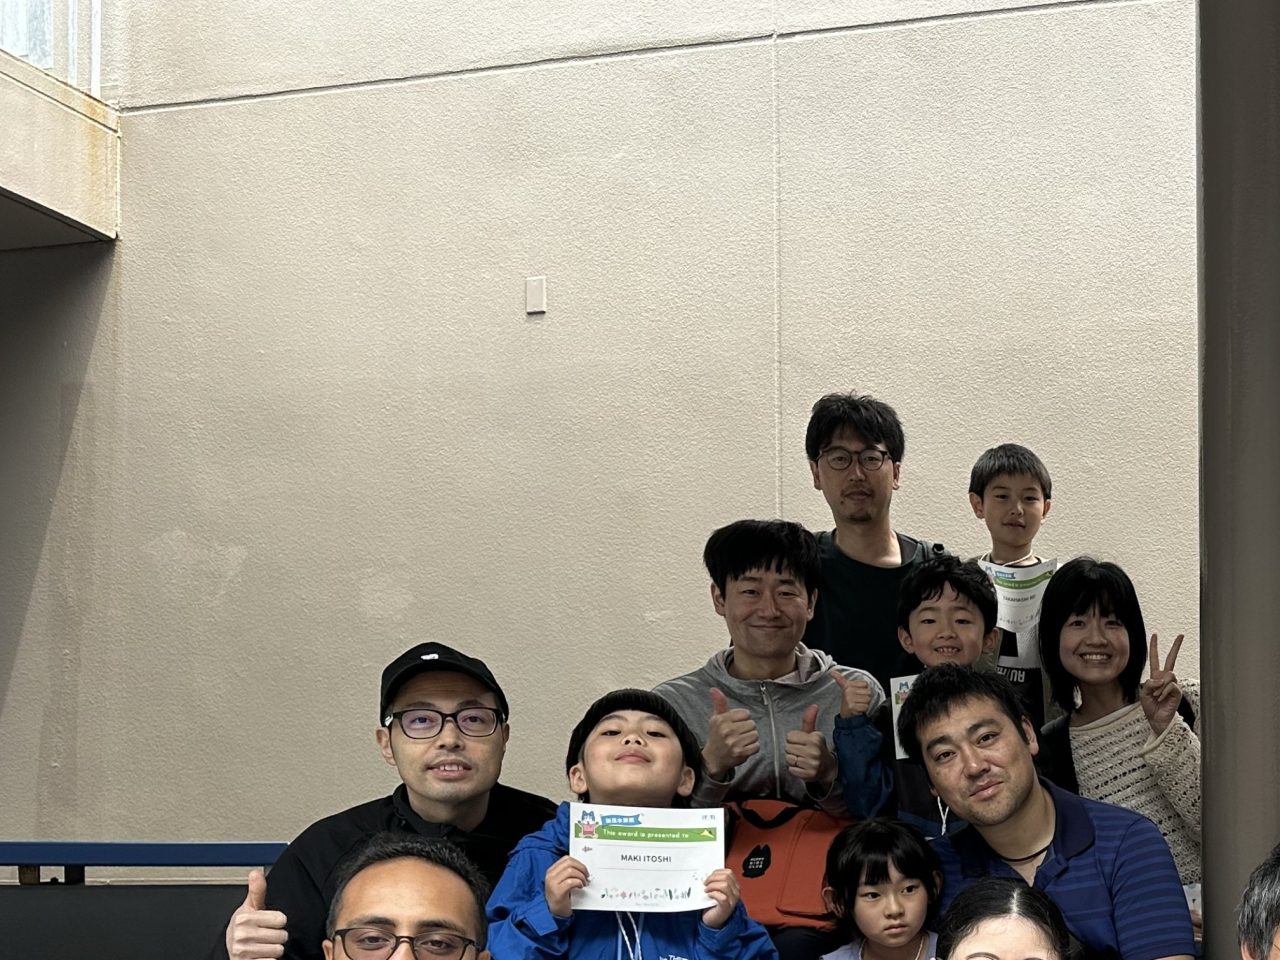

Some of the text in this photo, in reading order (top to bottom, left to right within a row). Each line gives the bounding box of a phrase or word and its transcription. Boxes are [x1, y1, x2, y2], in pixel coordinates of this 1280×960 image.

[647, 830, 680, 840] presented
[620, 854, 672, 863] MAKI ITOSHI
